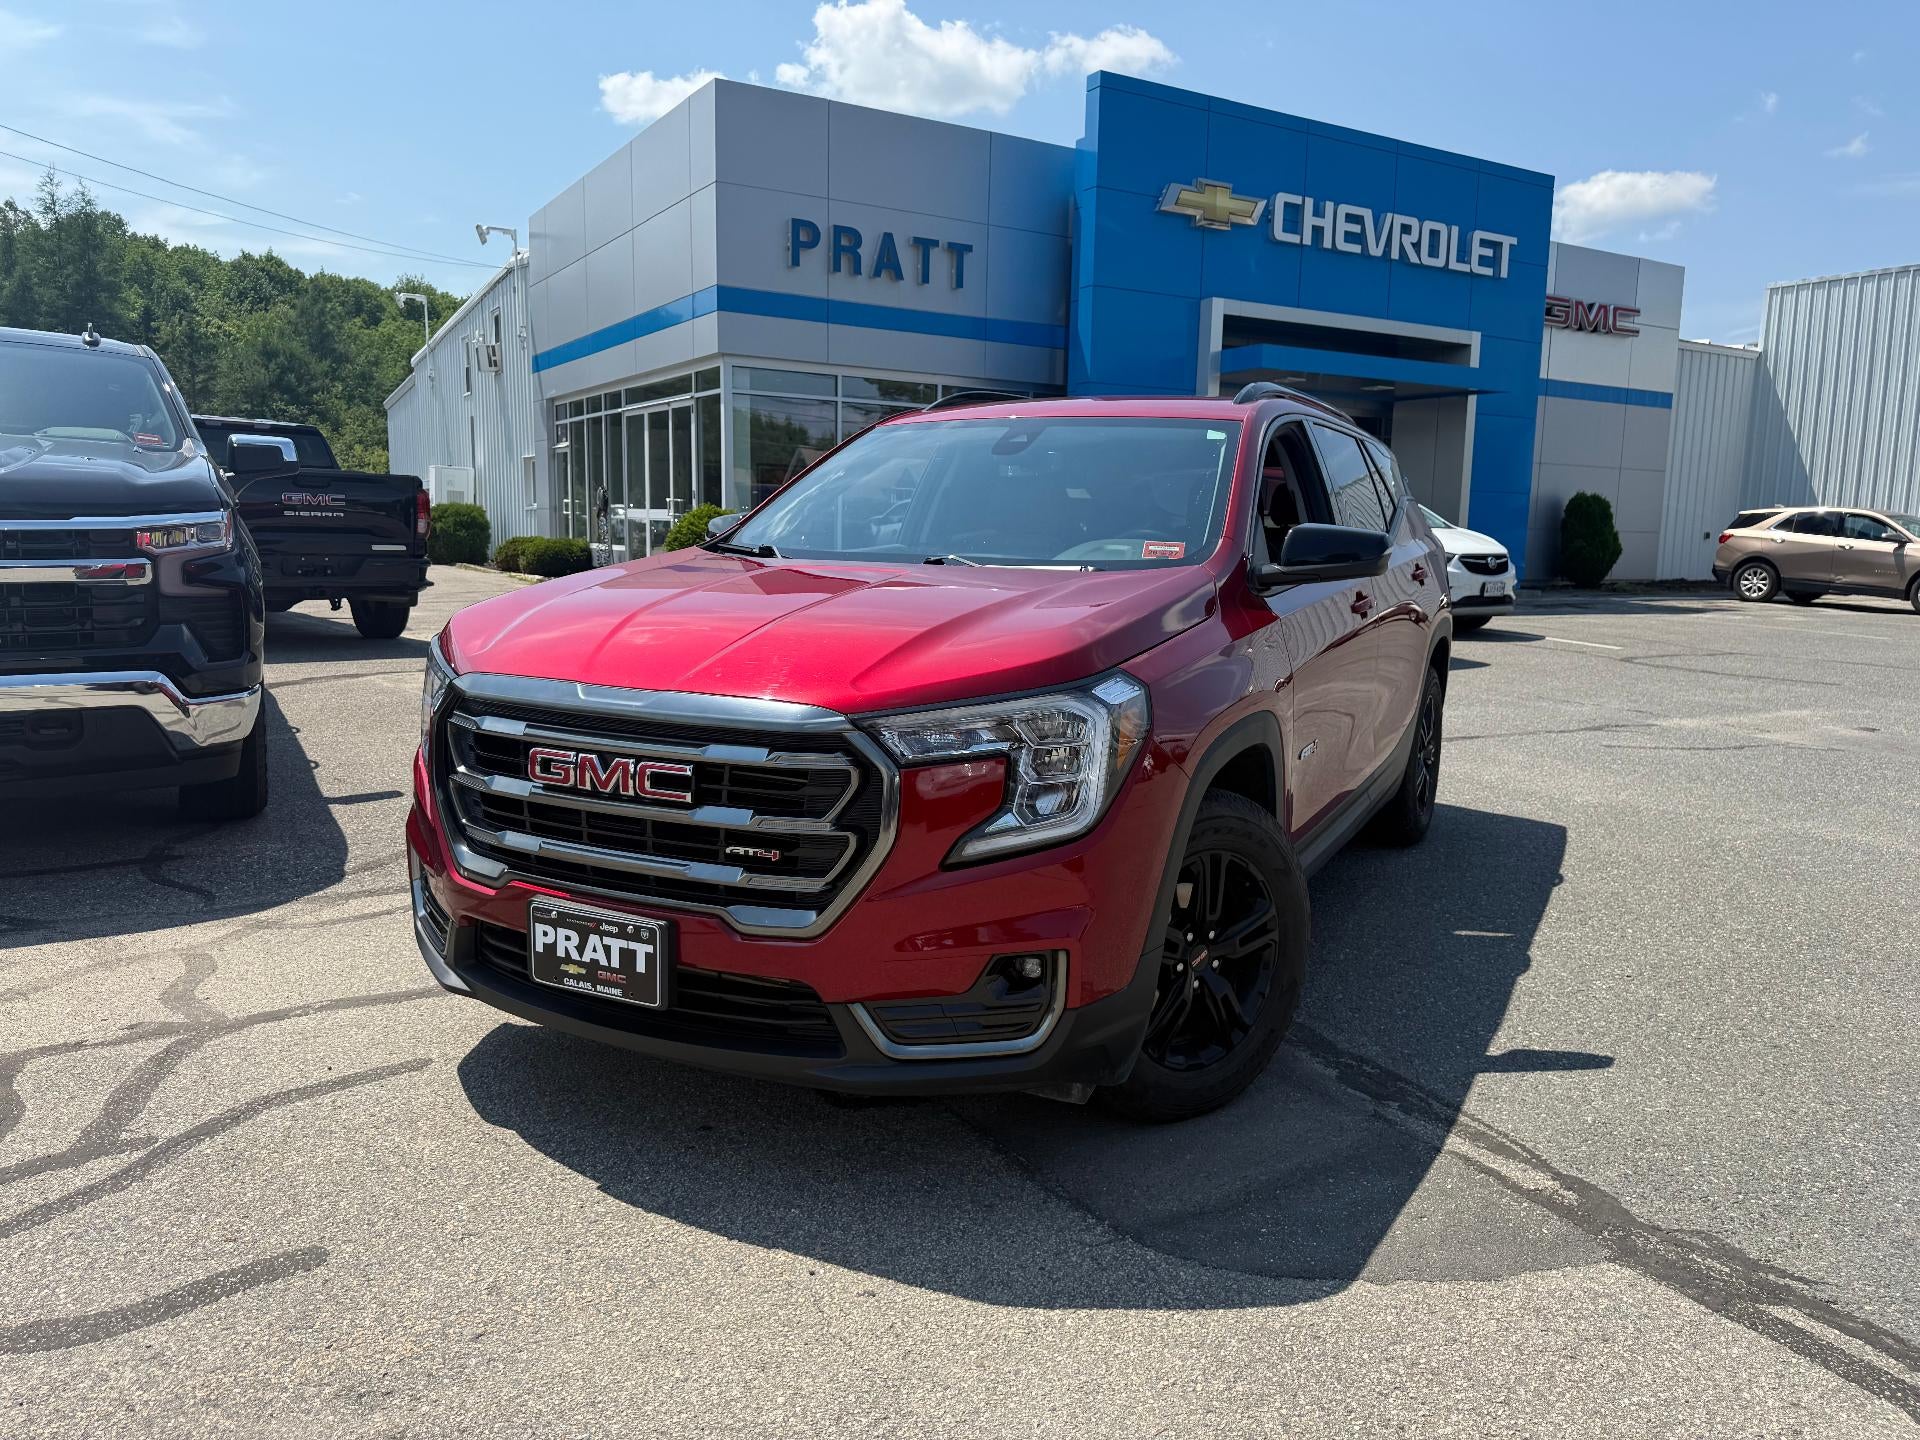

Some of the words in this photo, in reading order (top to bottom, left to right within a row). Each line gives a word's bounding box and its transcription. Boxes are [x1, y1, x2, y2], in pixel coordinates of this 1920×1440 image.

[1272, 191, 1518, 279] CHEVROLET
[789, 217, 974, 289] PRATT
[1544, 295, 1640, 337] GMC
[281, 492, 346, 506] GMC
[283, 510, 345, 518] SIERRA
[528, 747, 694, 804] GMC
[725, 846, 780, 861] AT4
[599, 922, 619, 934] Jeep
[534, 922, 654, 974] PRATT
[563, 977, 595, 992] CALAIS,
[596, 984, 623, 997] MAINE
[597, 970, 627, 984] GMC
